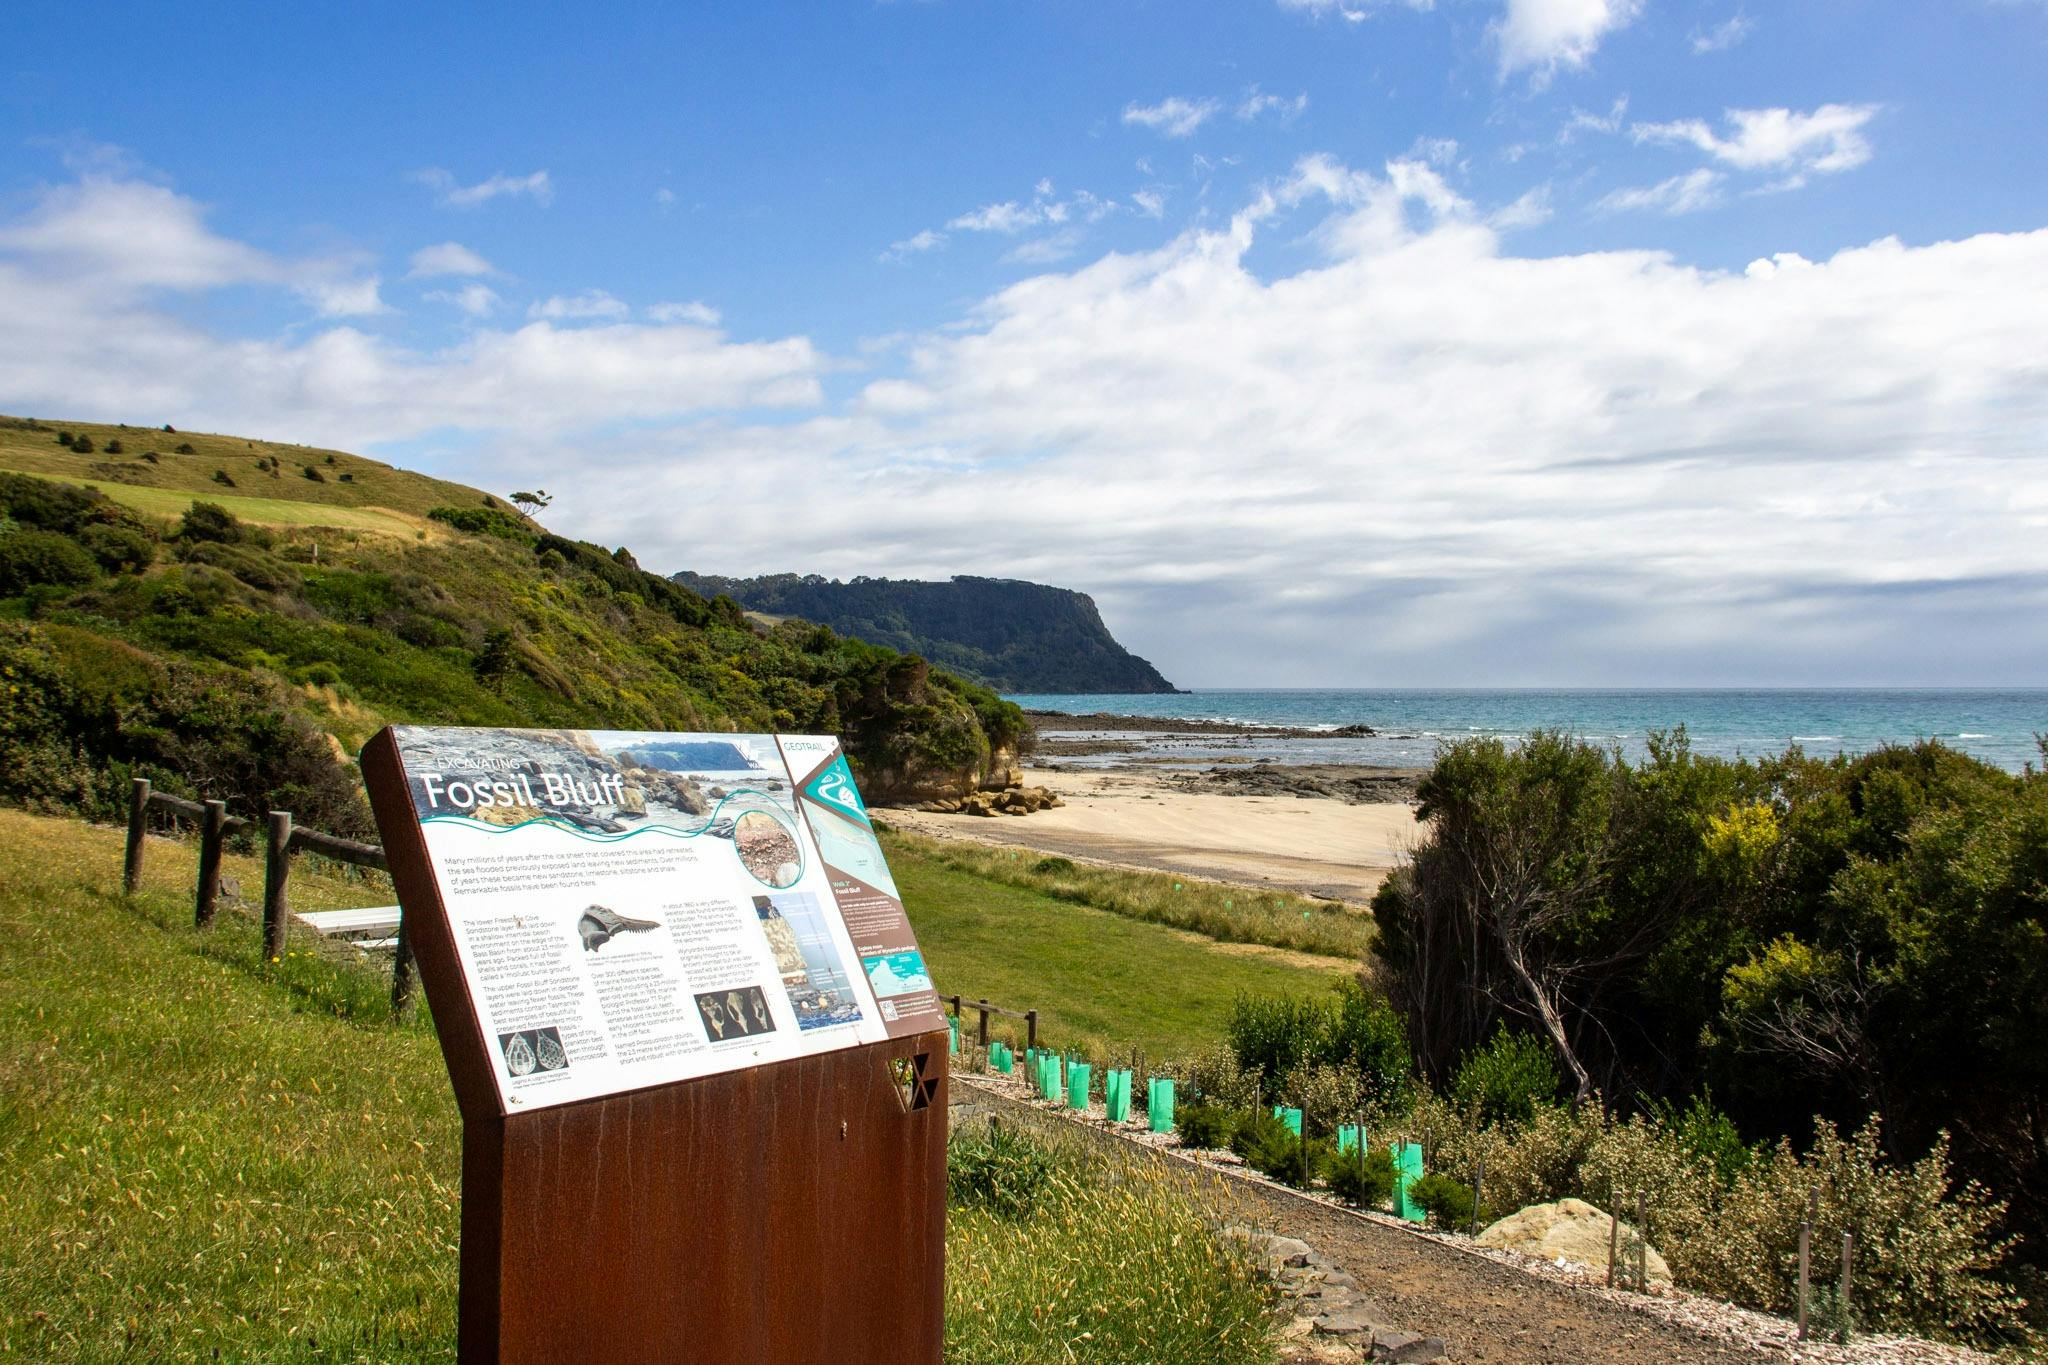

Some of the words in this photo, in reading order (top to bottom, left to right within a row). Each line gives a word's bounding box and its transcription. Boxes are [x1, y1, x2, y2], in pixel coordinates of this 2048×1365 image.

[783, 742, 827, 751] GEOTRAIL
[437, 758, 521, 770] EXCAVATING
[420, 773, 538, 809] Fossil
[541, 773, 627, 806] Bluff
